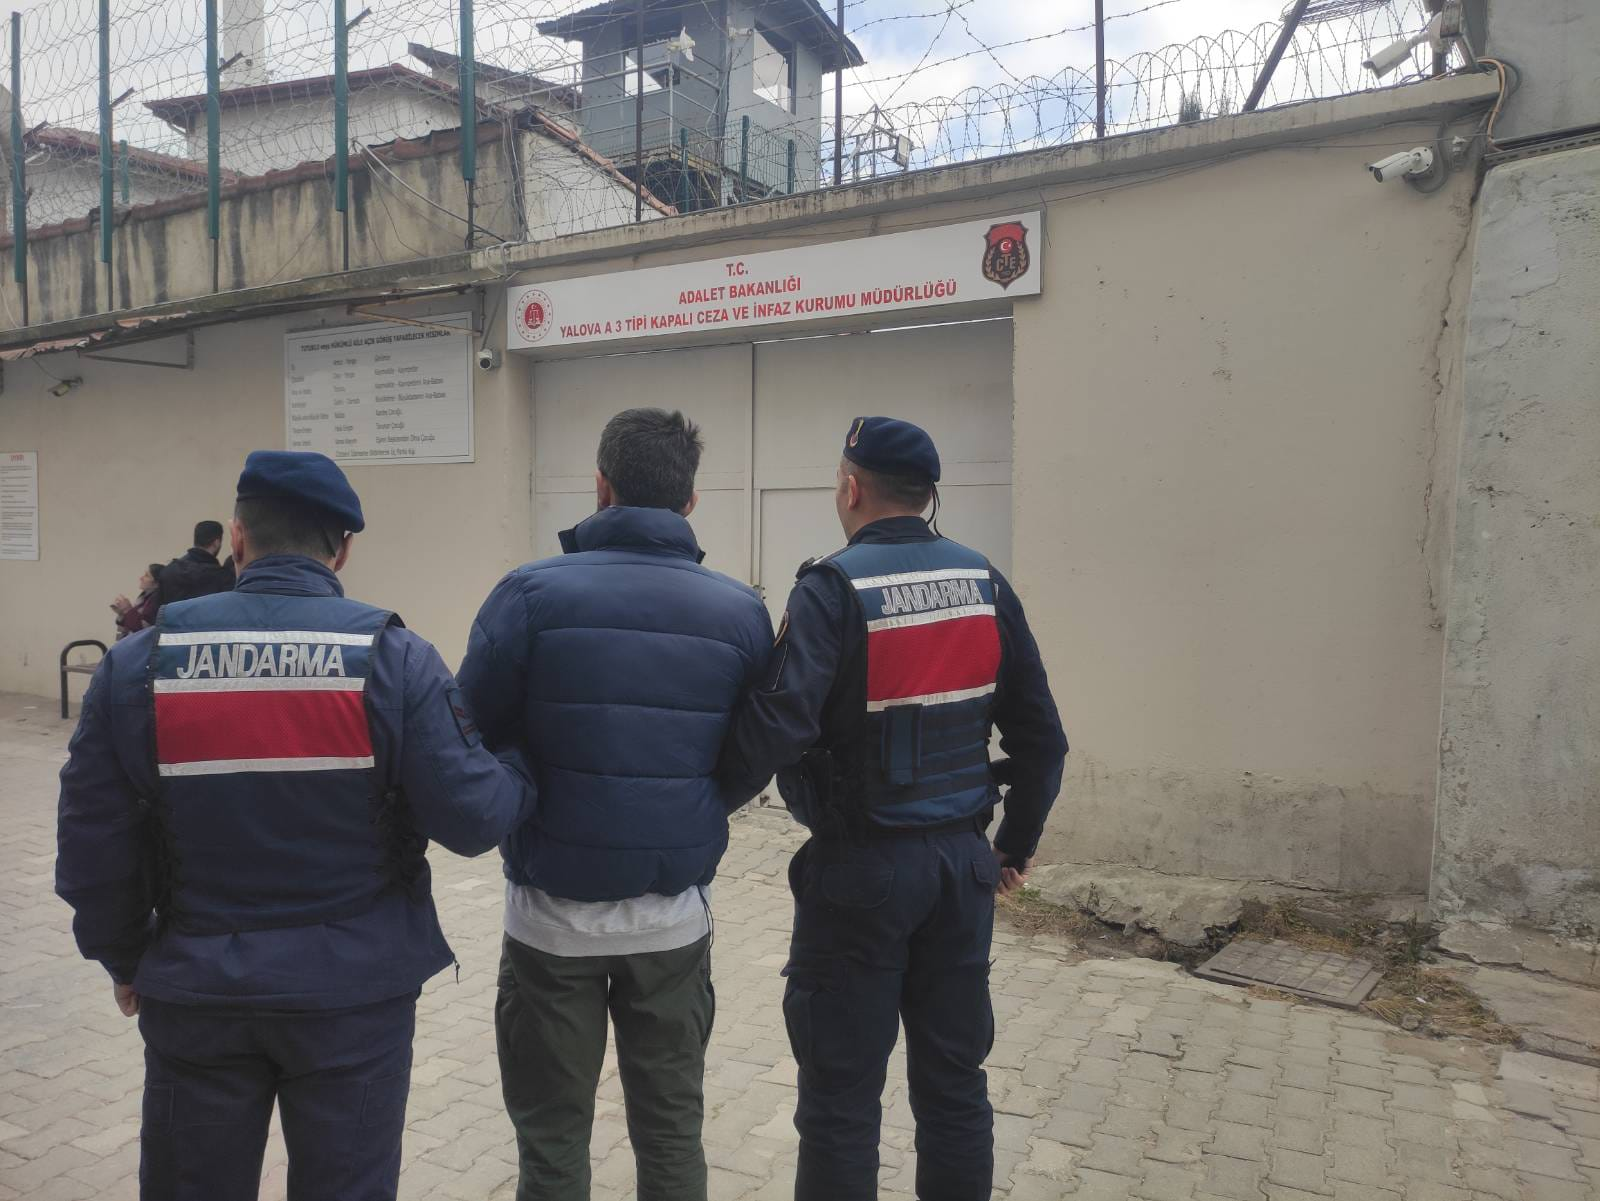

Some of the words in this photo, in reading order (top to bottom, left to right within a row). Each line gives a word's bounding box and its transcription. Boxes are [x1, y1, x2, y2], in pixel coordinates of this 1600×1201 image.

[726, 262, 748, 276] T.C.
[996, 254, 1016, 272] CTE
[679, 287, 725, 304] ADALET
[729, 275, 801, 298] BAKANLIĞI
[560, 322, 601, 338] YALOVA
[605, 321, 612, 334] A
[616, 320, 622, 333] 3
[625, 315, 647, 331] TİPİ
[651, 312, 693, 328] KAPALI
[697, 308, 729, 324] CEZA
[733, 306, 749, 320] VE
[753, 302, 791, 318] İNFAZ
[795, 294, 855, 313] KURUMU
[861, 279, 957, 306] MÜDÜRLÜĞÜ
[881, 580, 984, 615] JANDARMA
[176, 643, 346, 679] JANDARMA
